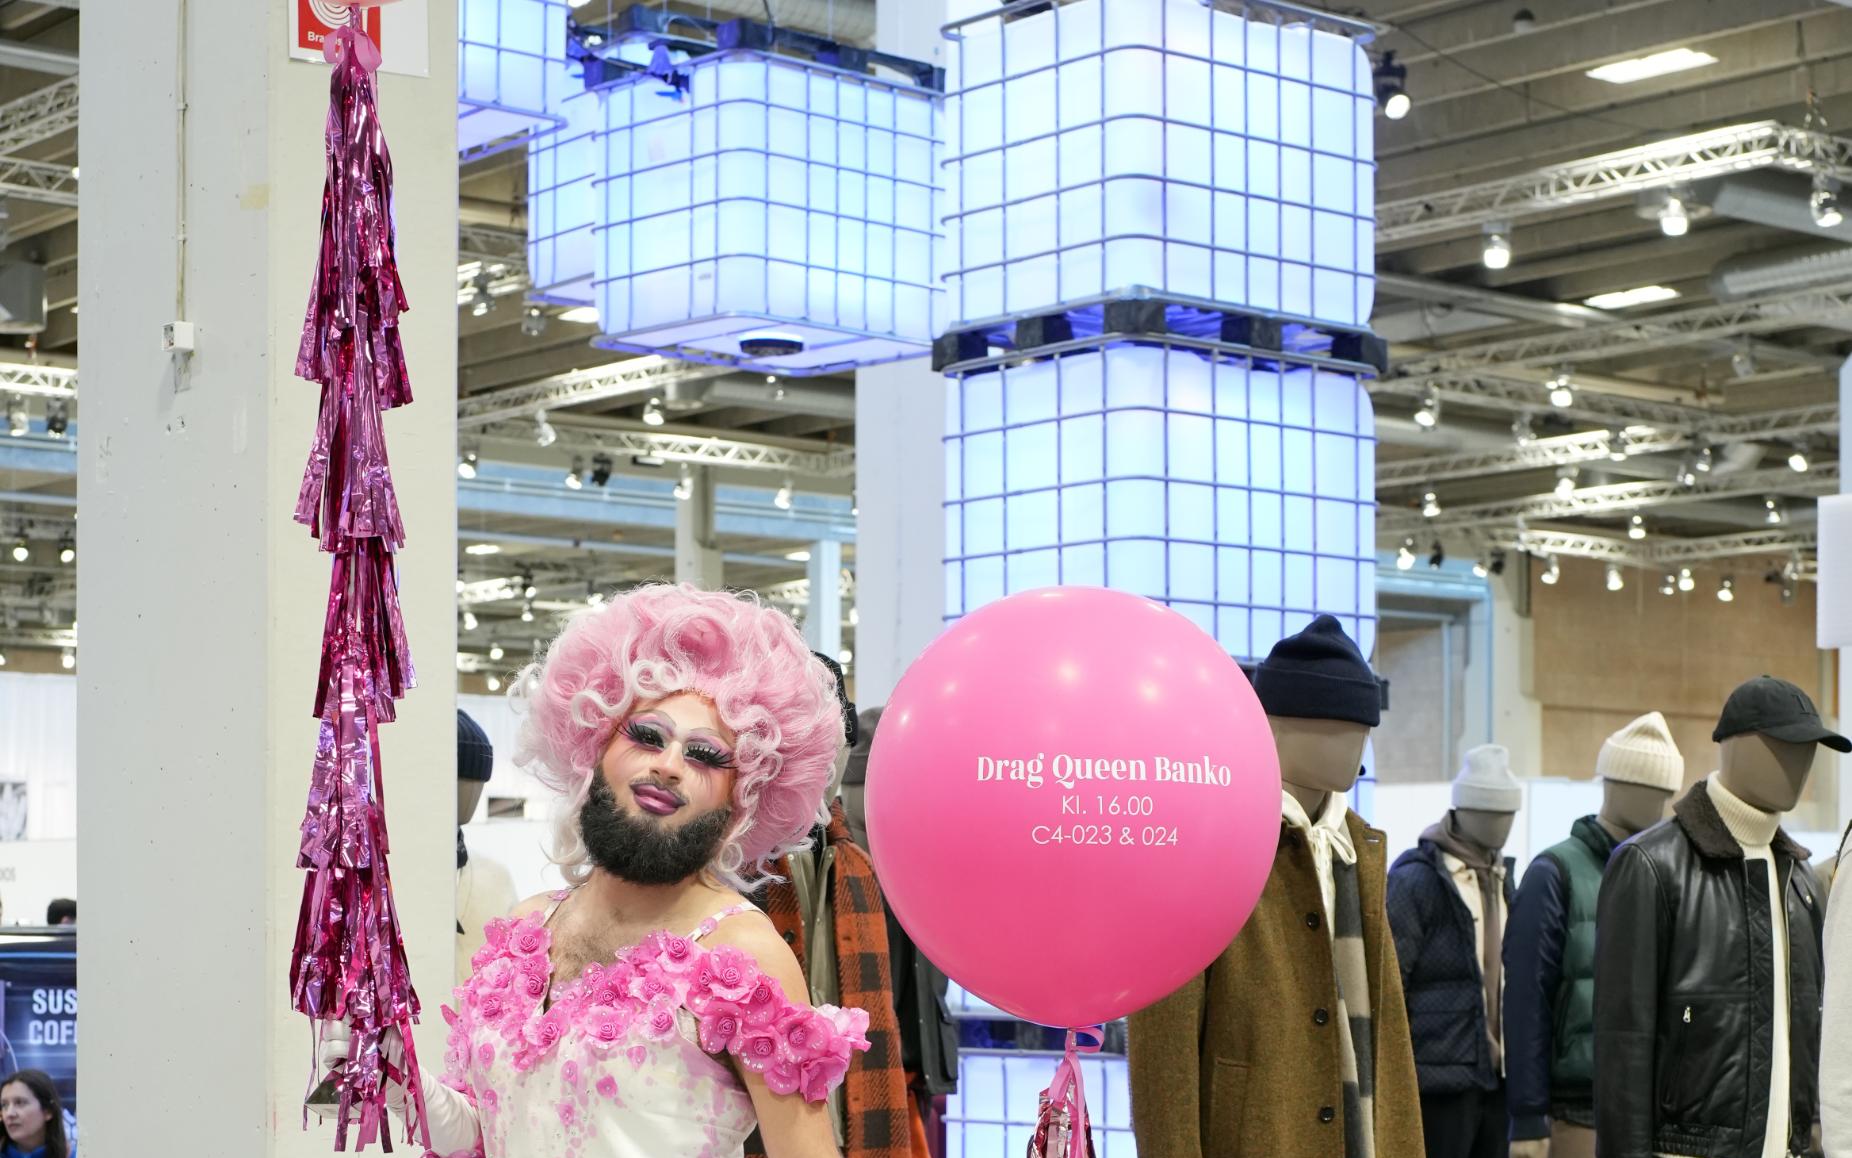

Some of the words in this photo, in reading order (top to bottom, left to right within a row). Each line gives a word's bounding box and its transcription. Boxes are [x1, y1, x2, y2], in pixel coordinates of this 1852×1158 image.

[976, 752, 1045, 789] Drag
[1052, 754, 1147, 790] Queen
[1154, 755, 1232, 787] Banko
[1061, 795, 1087, 815] Kl.
[1096, 795, 1154, 816] 16.00
[1031, 825, 1113, 846] C4-023
[1118, 826, 1136, 846] &
[1141, 825, 1179, 847] 024
